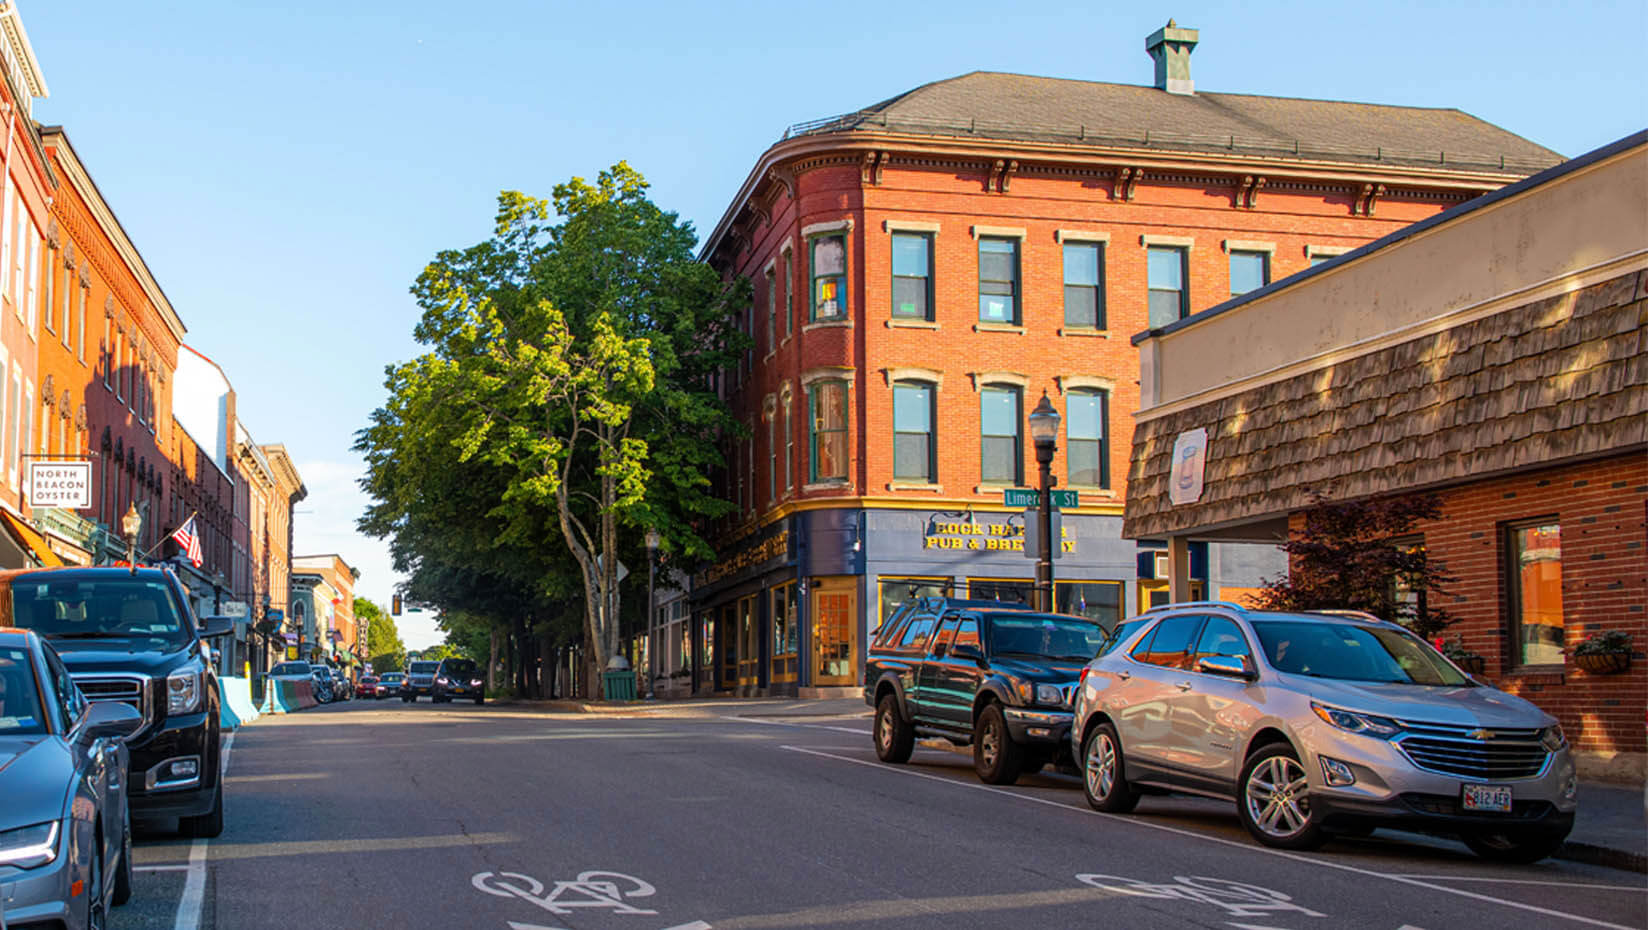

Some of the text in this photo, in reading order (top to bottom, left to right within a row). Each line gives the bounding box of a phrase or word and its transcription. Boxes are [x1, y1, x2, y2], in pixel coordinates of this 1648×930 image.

[36, 470, 77, 478] NORTH
[36, 481, 84, 489] BEACON
[36, 491, 80, 500] OYSTER
[1007, 491, 1076, 506] Limerk St
[927, 536, 963, 550] PUB
[968, 537, 980, 550] &
